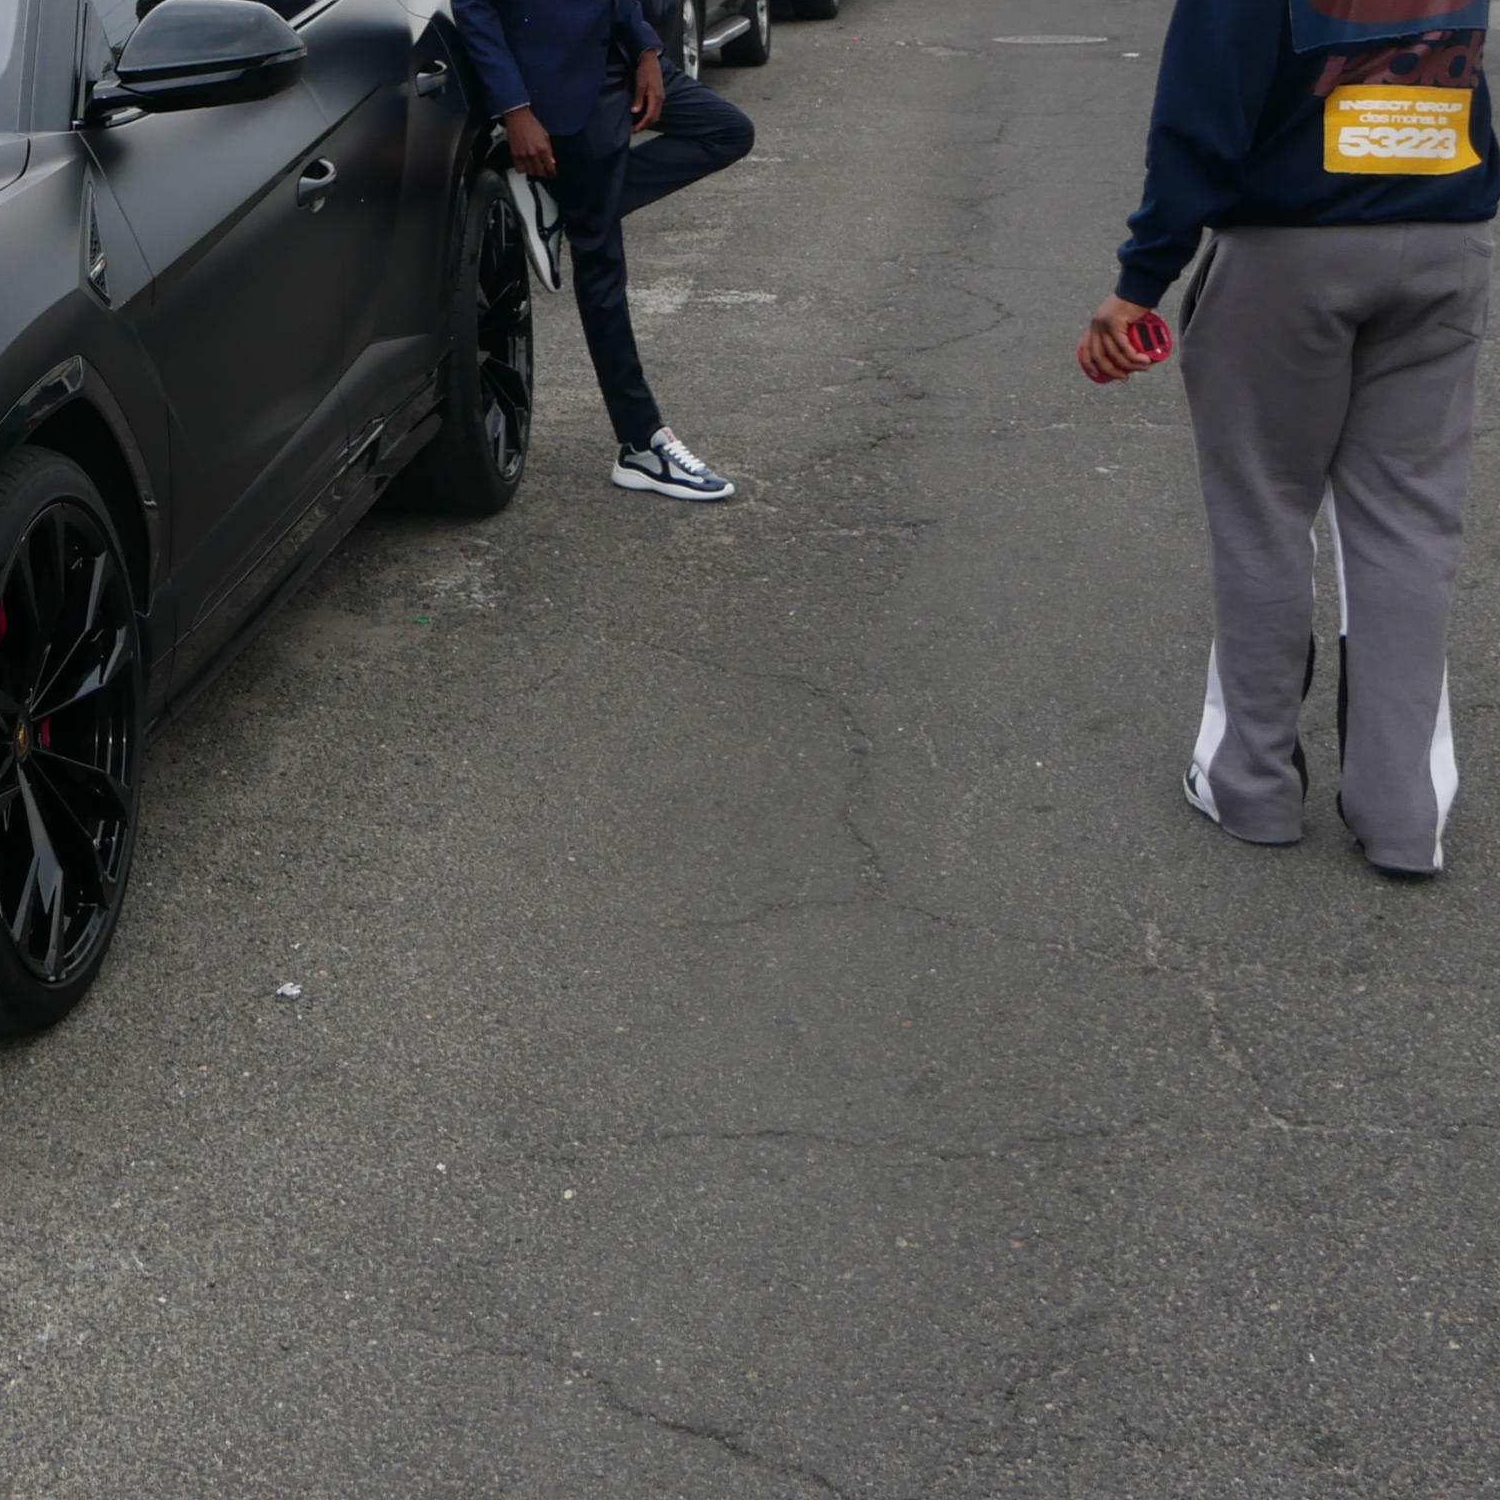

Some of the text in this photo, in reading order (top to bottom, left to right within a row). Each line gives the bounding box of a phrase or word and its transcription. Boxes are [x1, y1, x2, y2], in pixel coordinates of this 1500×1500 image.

[1338, 99, 1463, 113] INSECT GROUP
[1338, 126, 1457, 159] 53223
